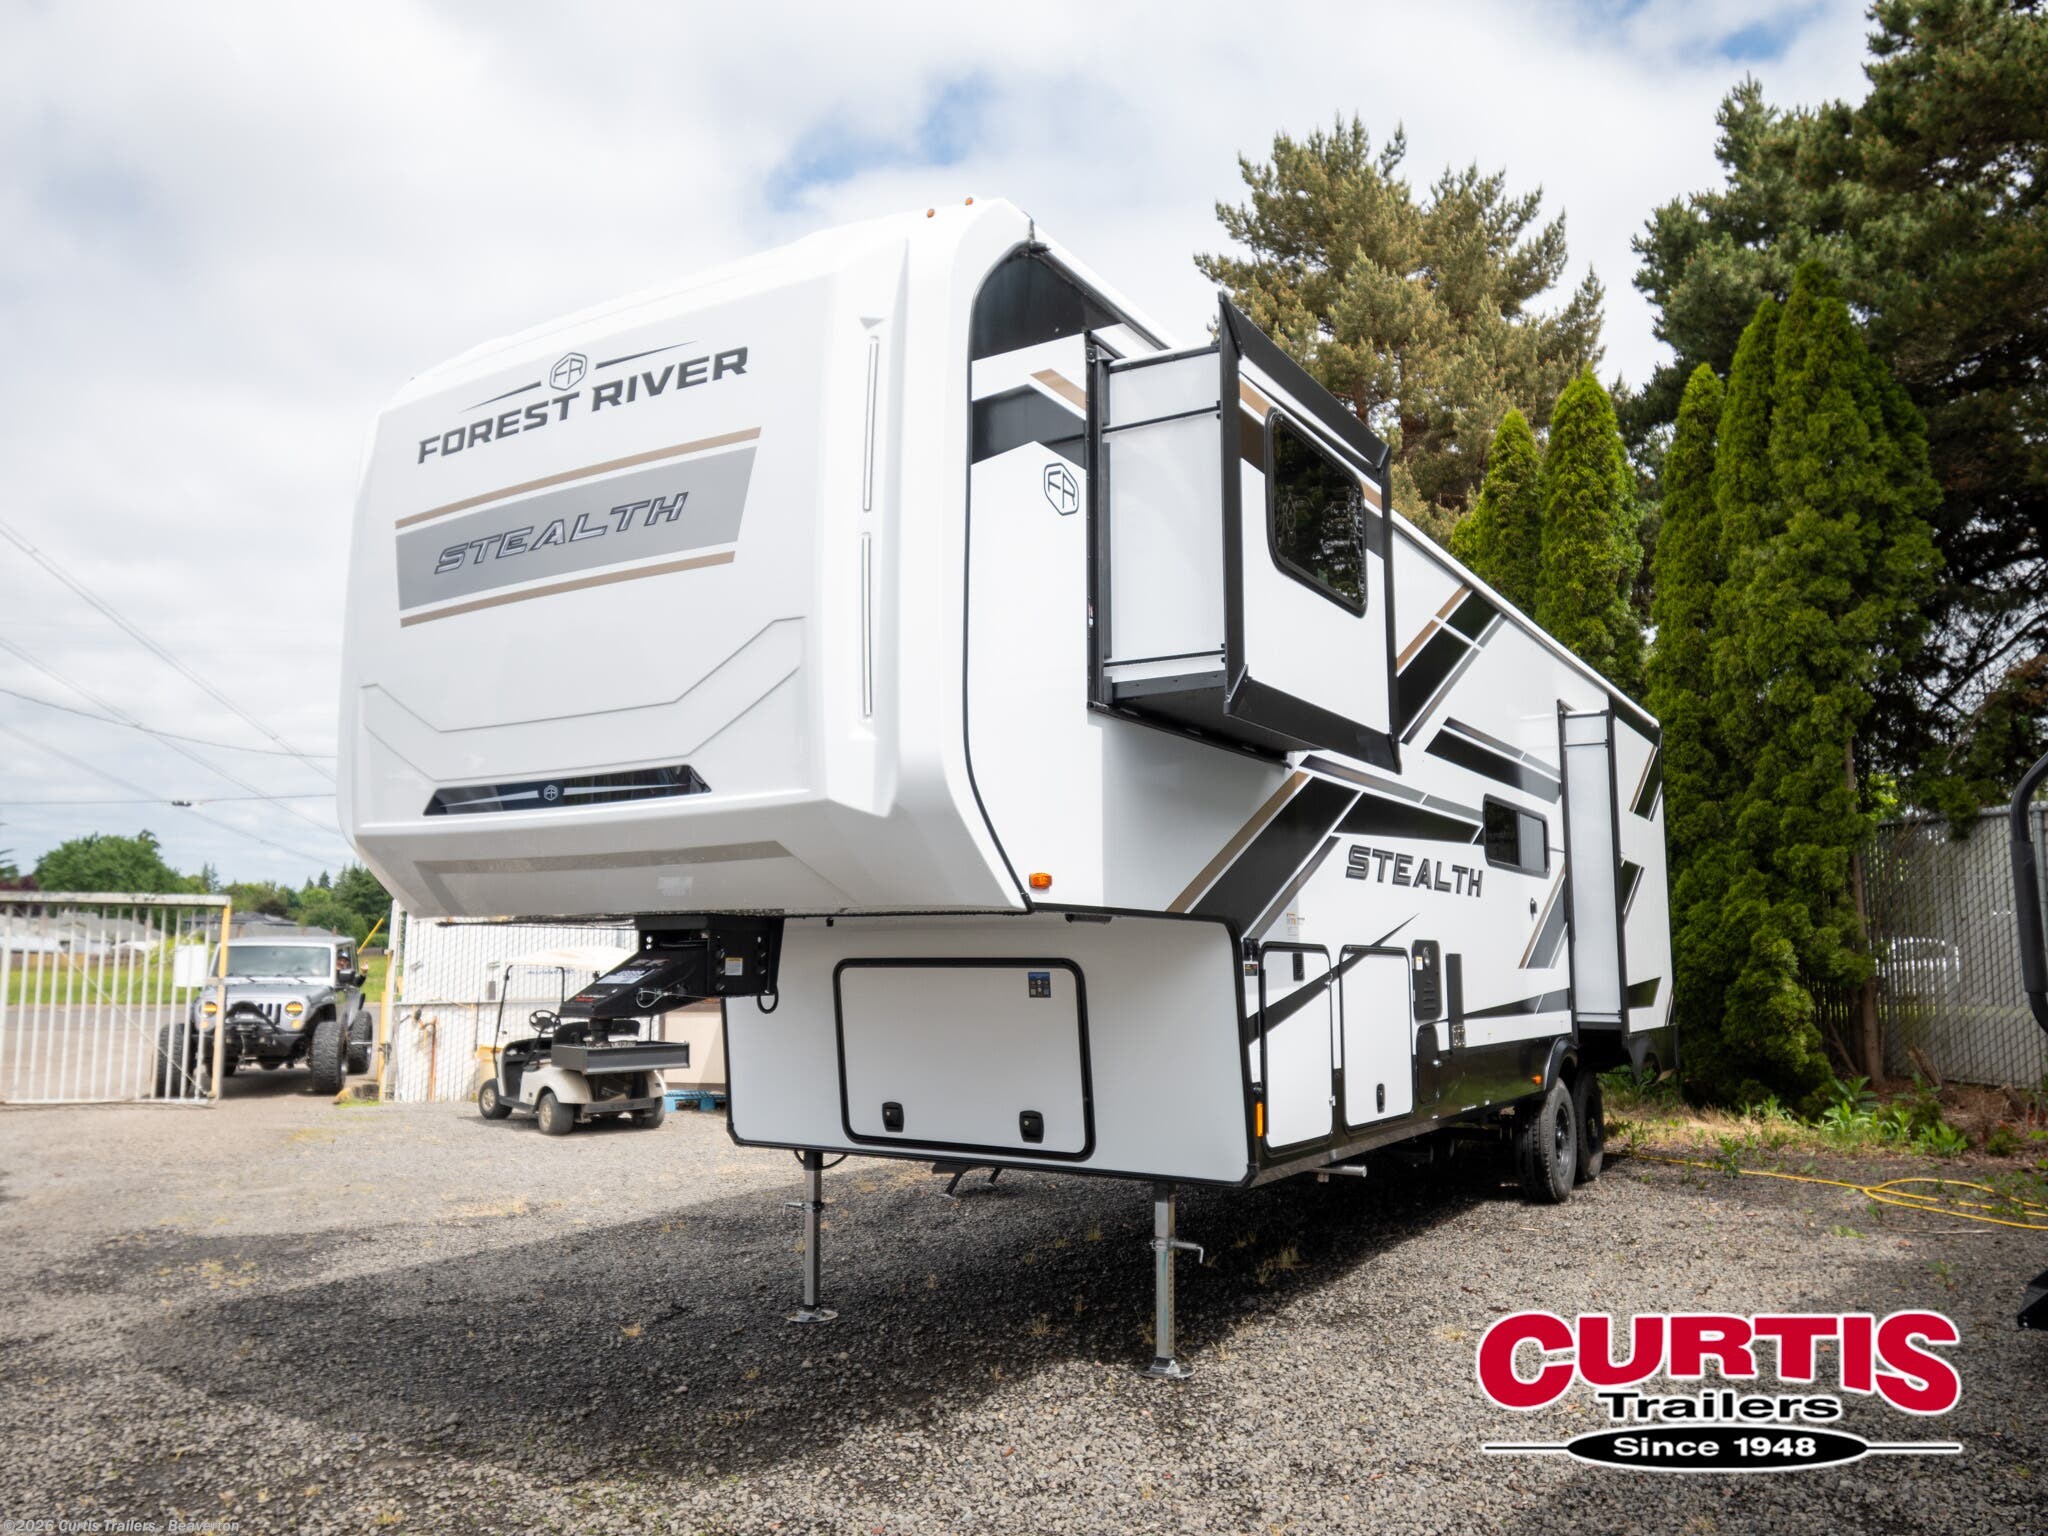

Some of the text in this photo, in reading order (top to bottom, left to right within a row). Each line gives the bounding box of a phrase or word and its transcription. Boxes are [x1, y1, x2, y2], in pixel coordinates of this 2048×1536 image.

[418, 346, 749, 465] FOREST RIVER
[434, 491, 689, 575] STEALTH
[1345, 844, 1484, 898] STEALTH
